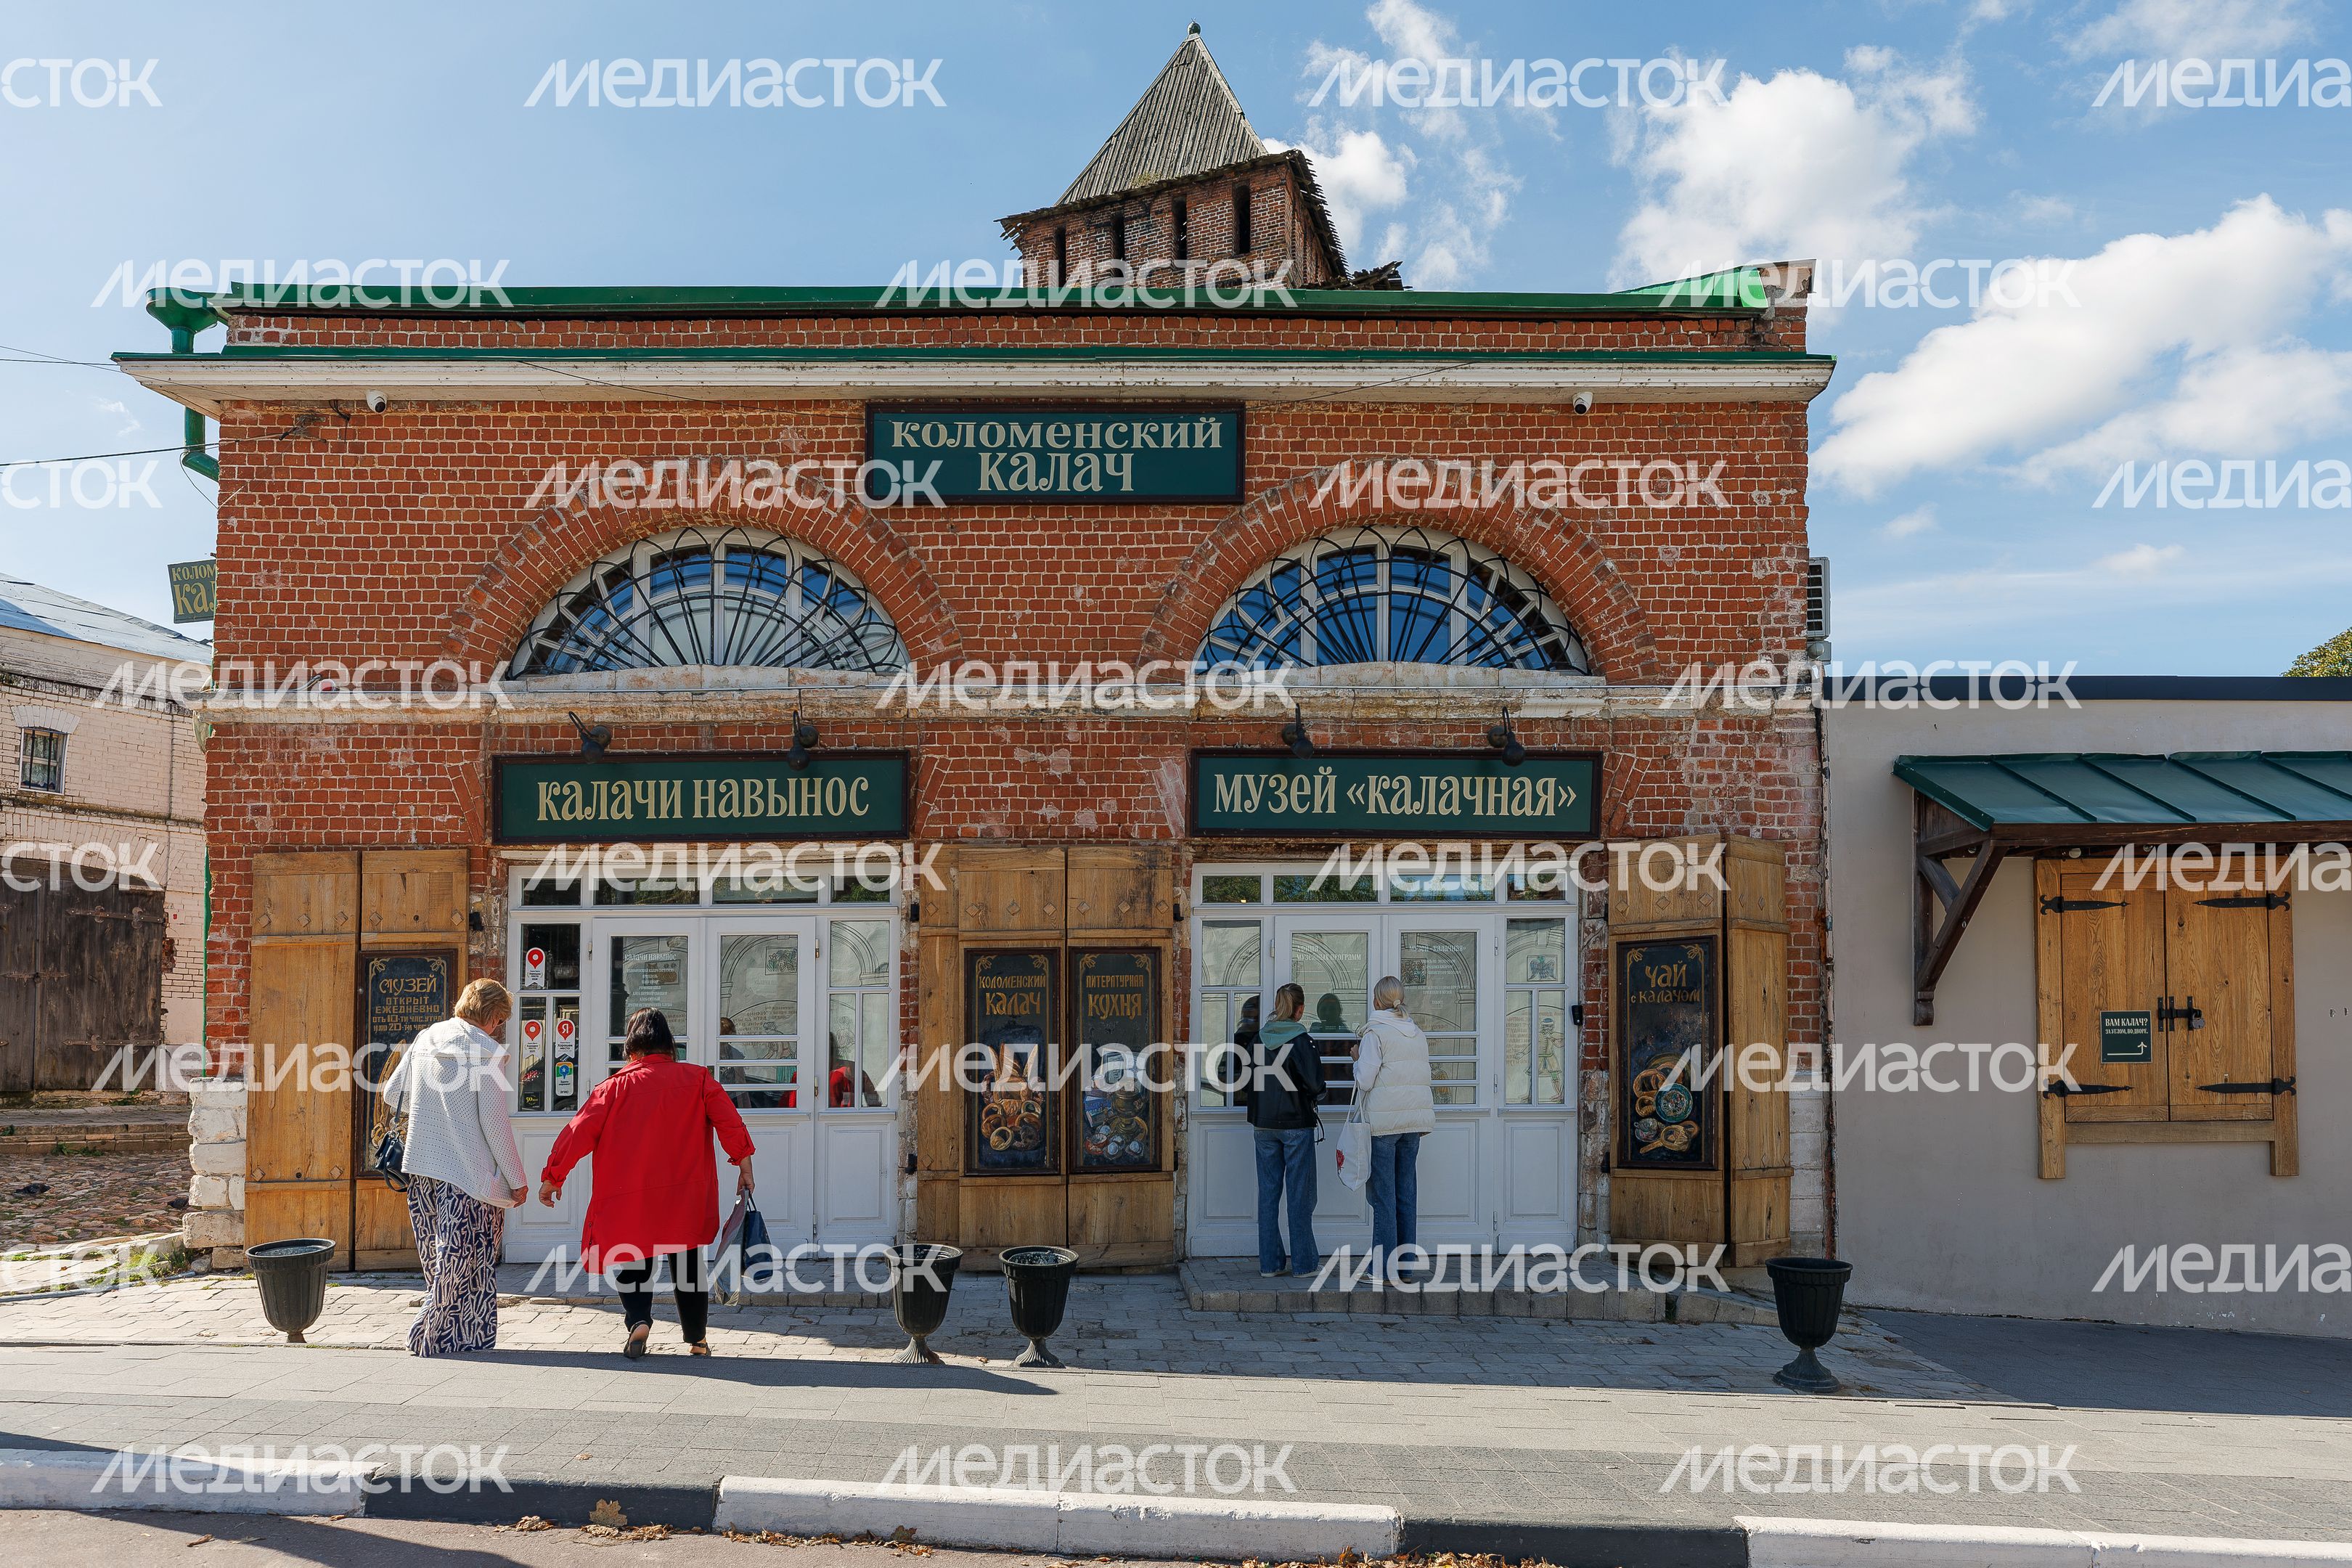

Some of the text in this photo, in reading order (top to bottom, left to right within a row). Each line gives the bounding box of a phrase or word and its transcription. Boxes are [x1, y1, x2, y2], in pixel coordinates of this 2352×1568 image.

[379, 973, 436, 996] МУЗЕЙ
[385, 997, 430, 1005] ОТКРЫТ
[375, 1005, 440, 1014] ЕЖЕДНЕВНО
[2105, 1018, 2148, 1026] ВАМ КАЛАЧ?
